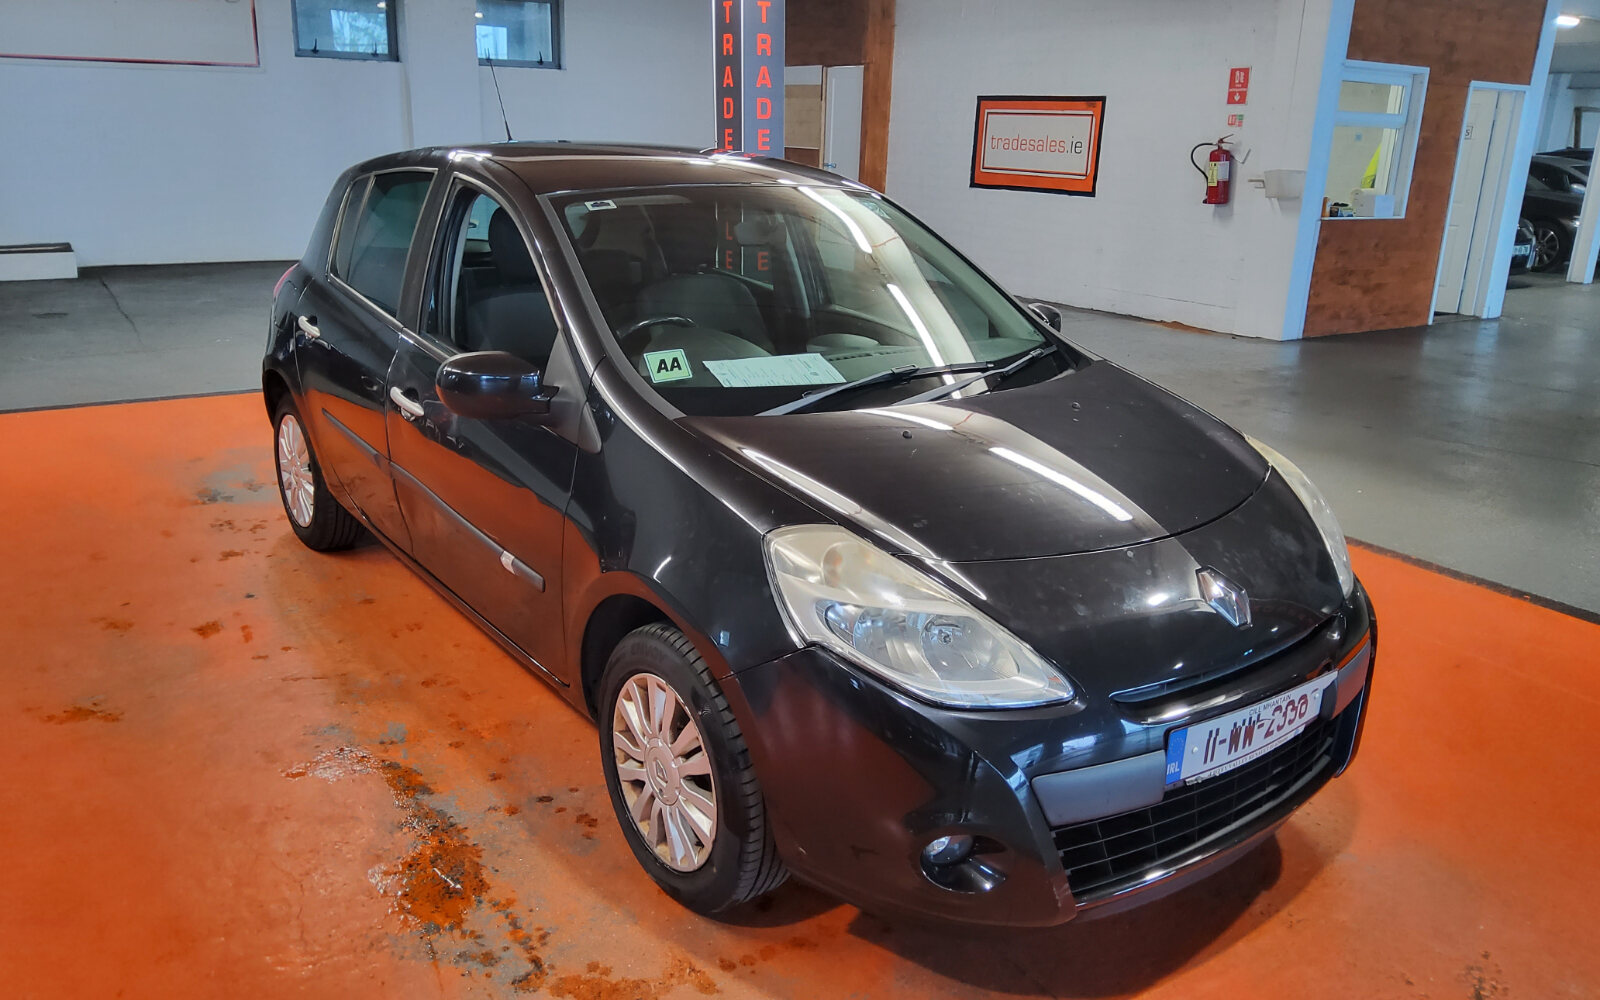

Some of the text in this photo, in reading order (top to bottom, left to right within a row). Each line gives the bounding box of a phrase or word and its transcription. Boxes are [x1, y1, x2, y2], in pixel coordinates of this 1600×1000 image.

[723, 1, 734, 150] TRADE
[756, 1, 772, 151] TRADE
[991, 134, 1083, 155] tradesales.ie
[656, 357, 683, 374] AA
[1166, 761, 1180, 775] IRL
